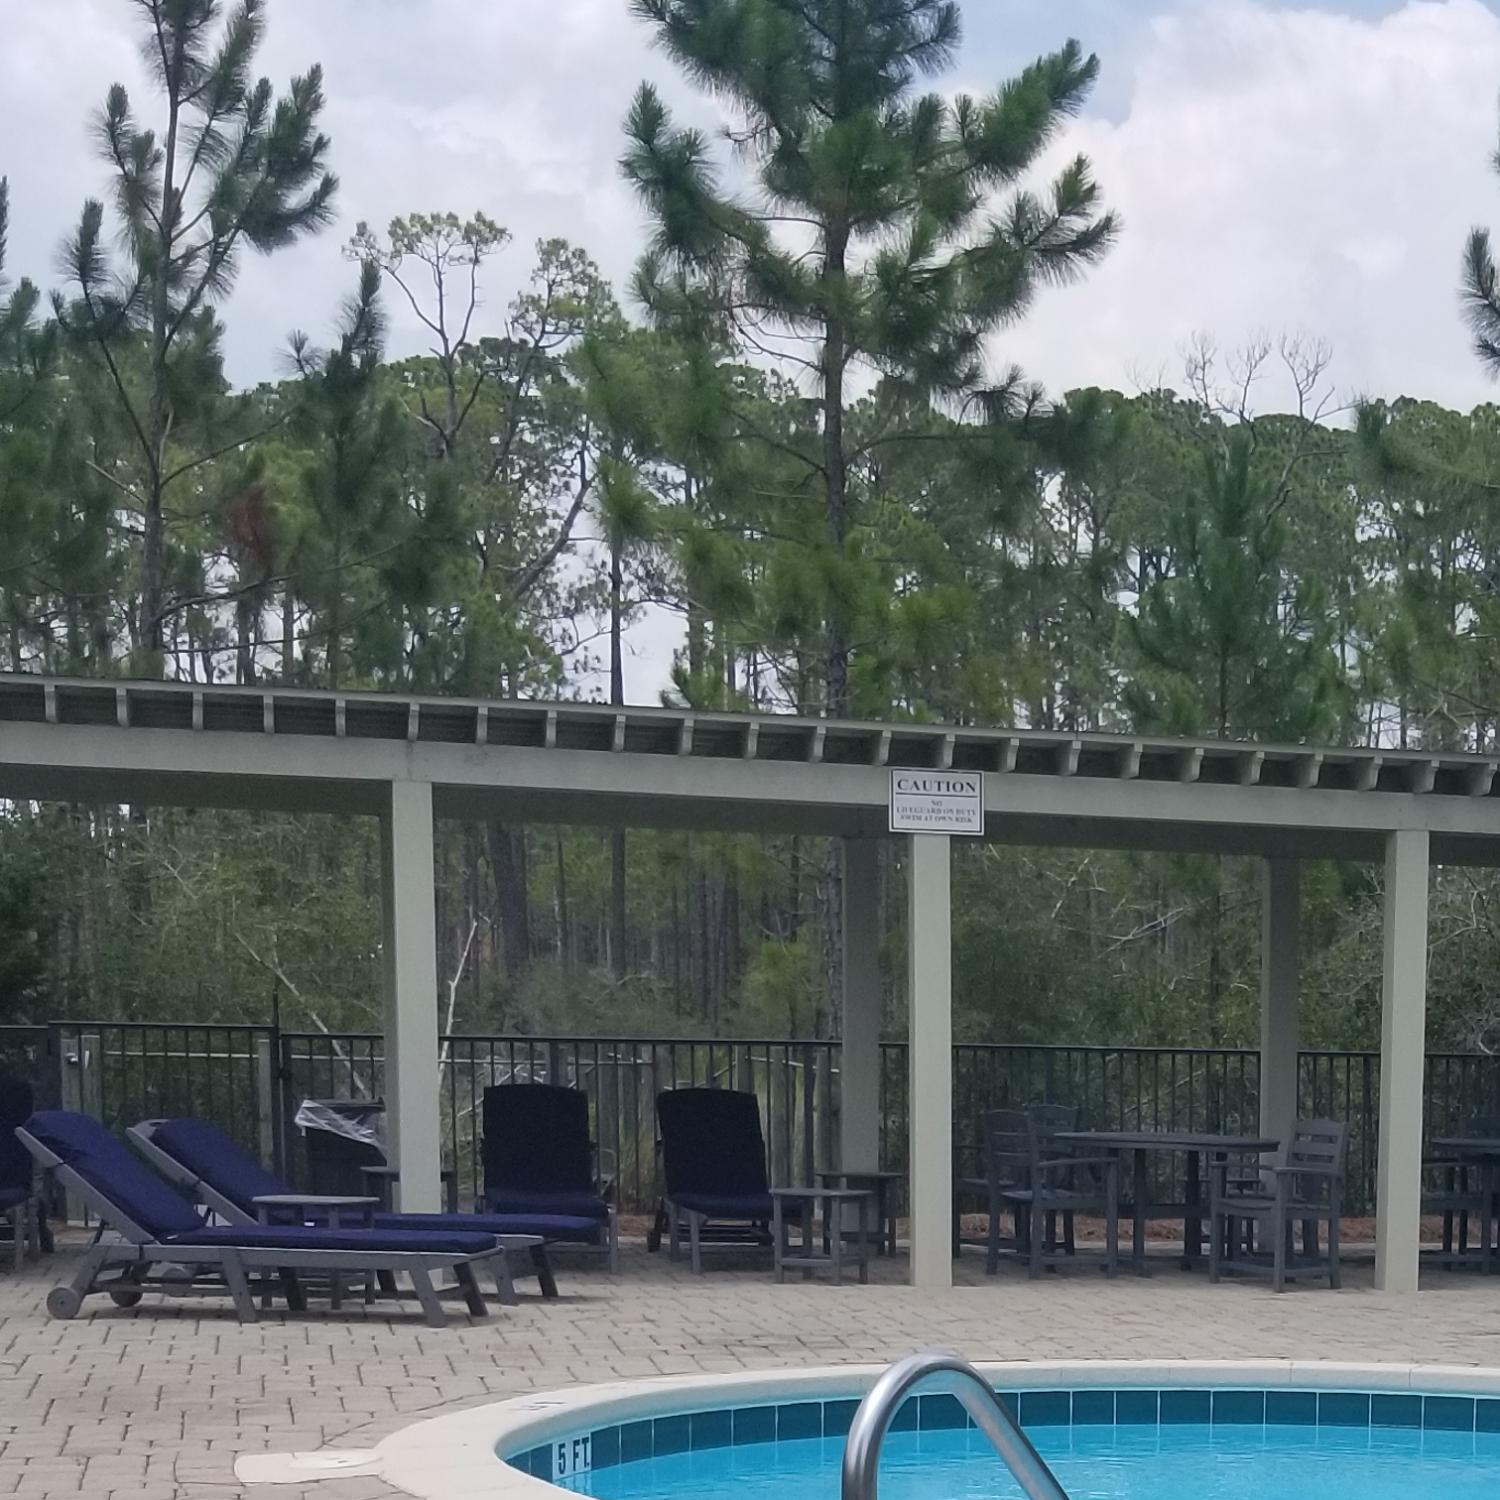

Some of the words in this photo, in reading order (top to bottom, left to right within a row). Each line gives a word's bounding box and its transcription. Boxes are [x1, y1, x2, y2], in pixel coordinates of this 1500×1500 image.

[897, 779, 976, 793] CAUTION
[558, 1443, 566, 1474] 5
[573, 1436, 590, 1471] FT.
